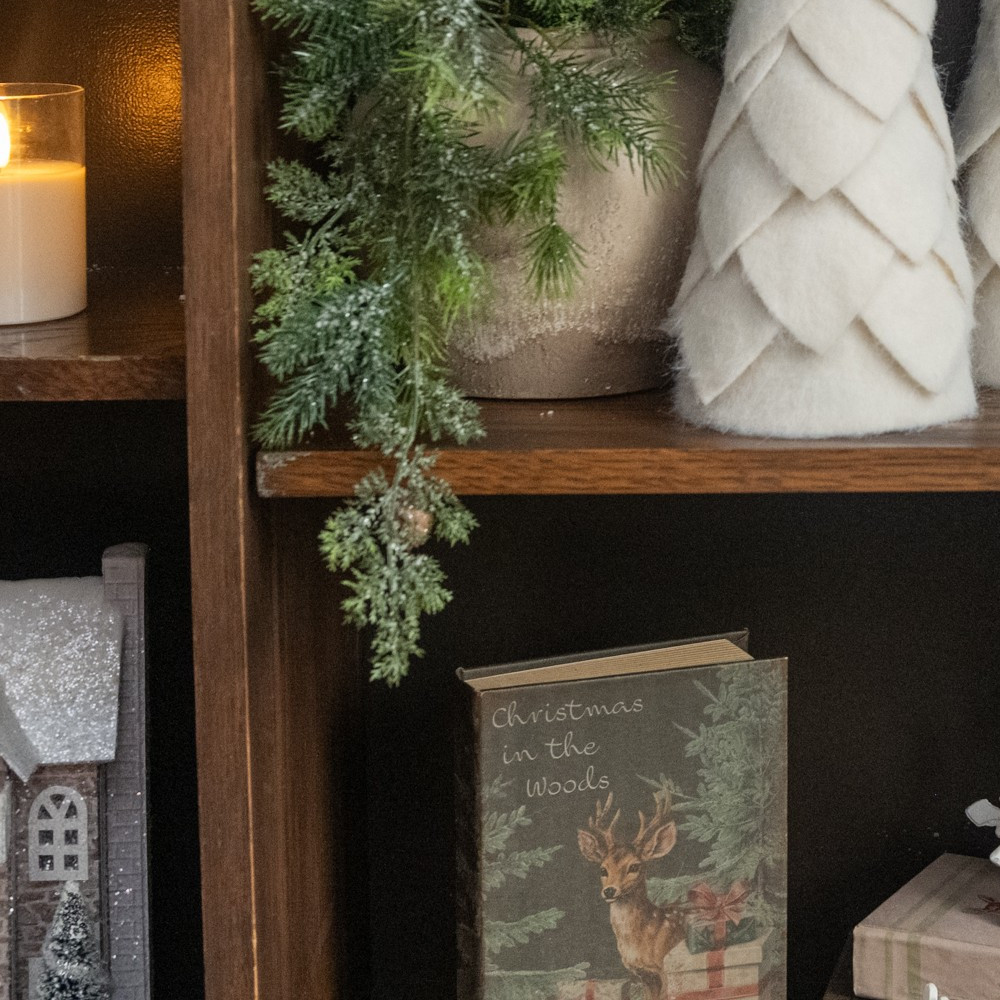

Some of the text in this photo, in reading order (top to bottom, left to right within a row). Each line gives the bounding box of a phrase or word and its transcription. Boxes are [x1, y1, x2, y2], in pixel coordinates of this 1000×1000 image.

[492, 698, 644, 729] Christmas
[502, 730, 600, 765] in the
[526, 765, 610, 798] Woods
